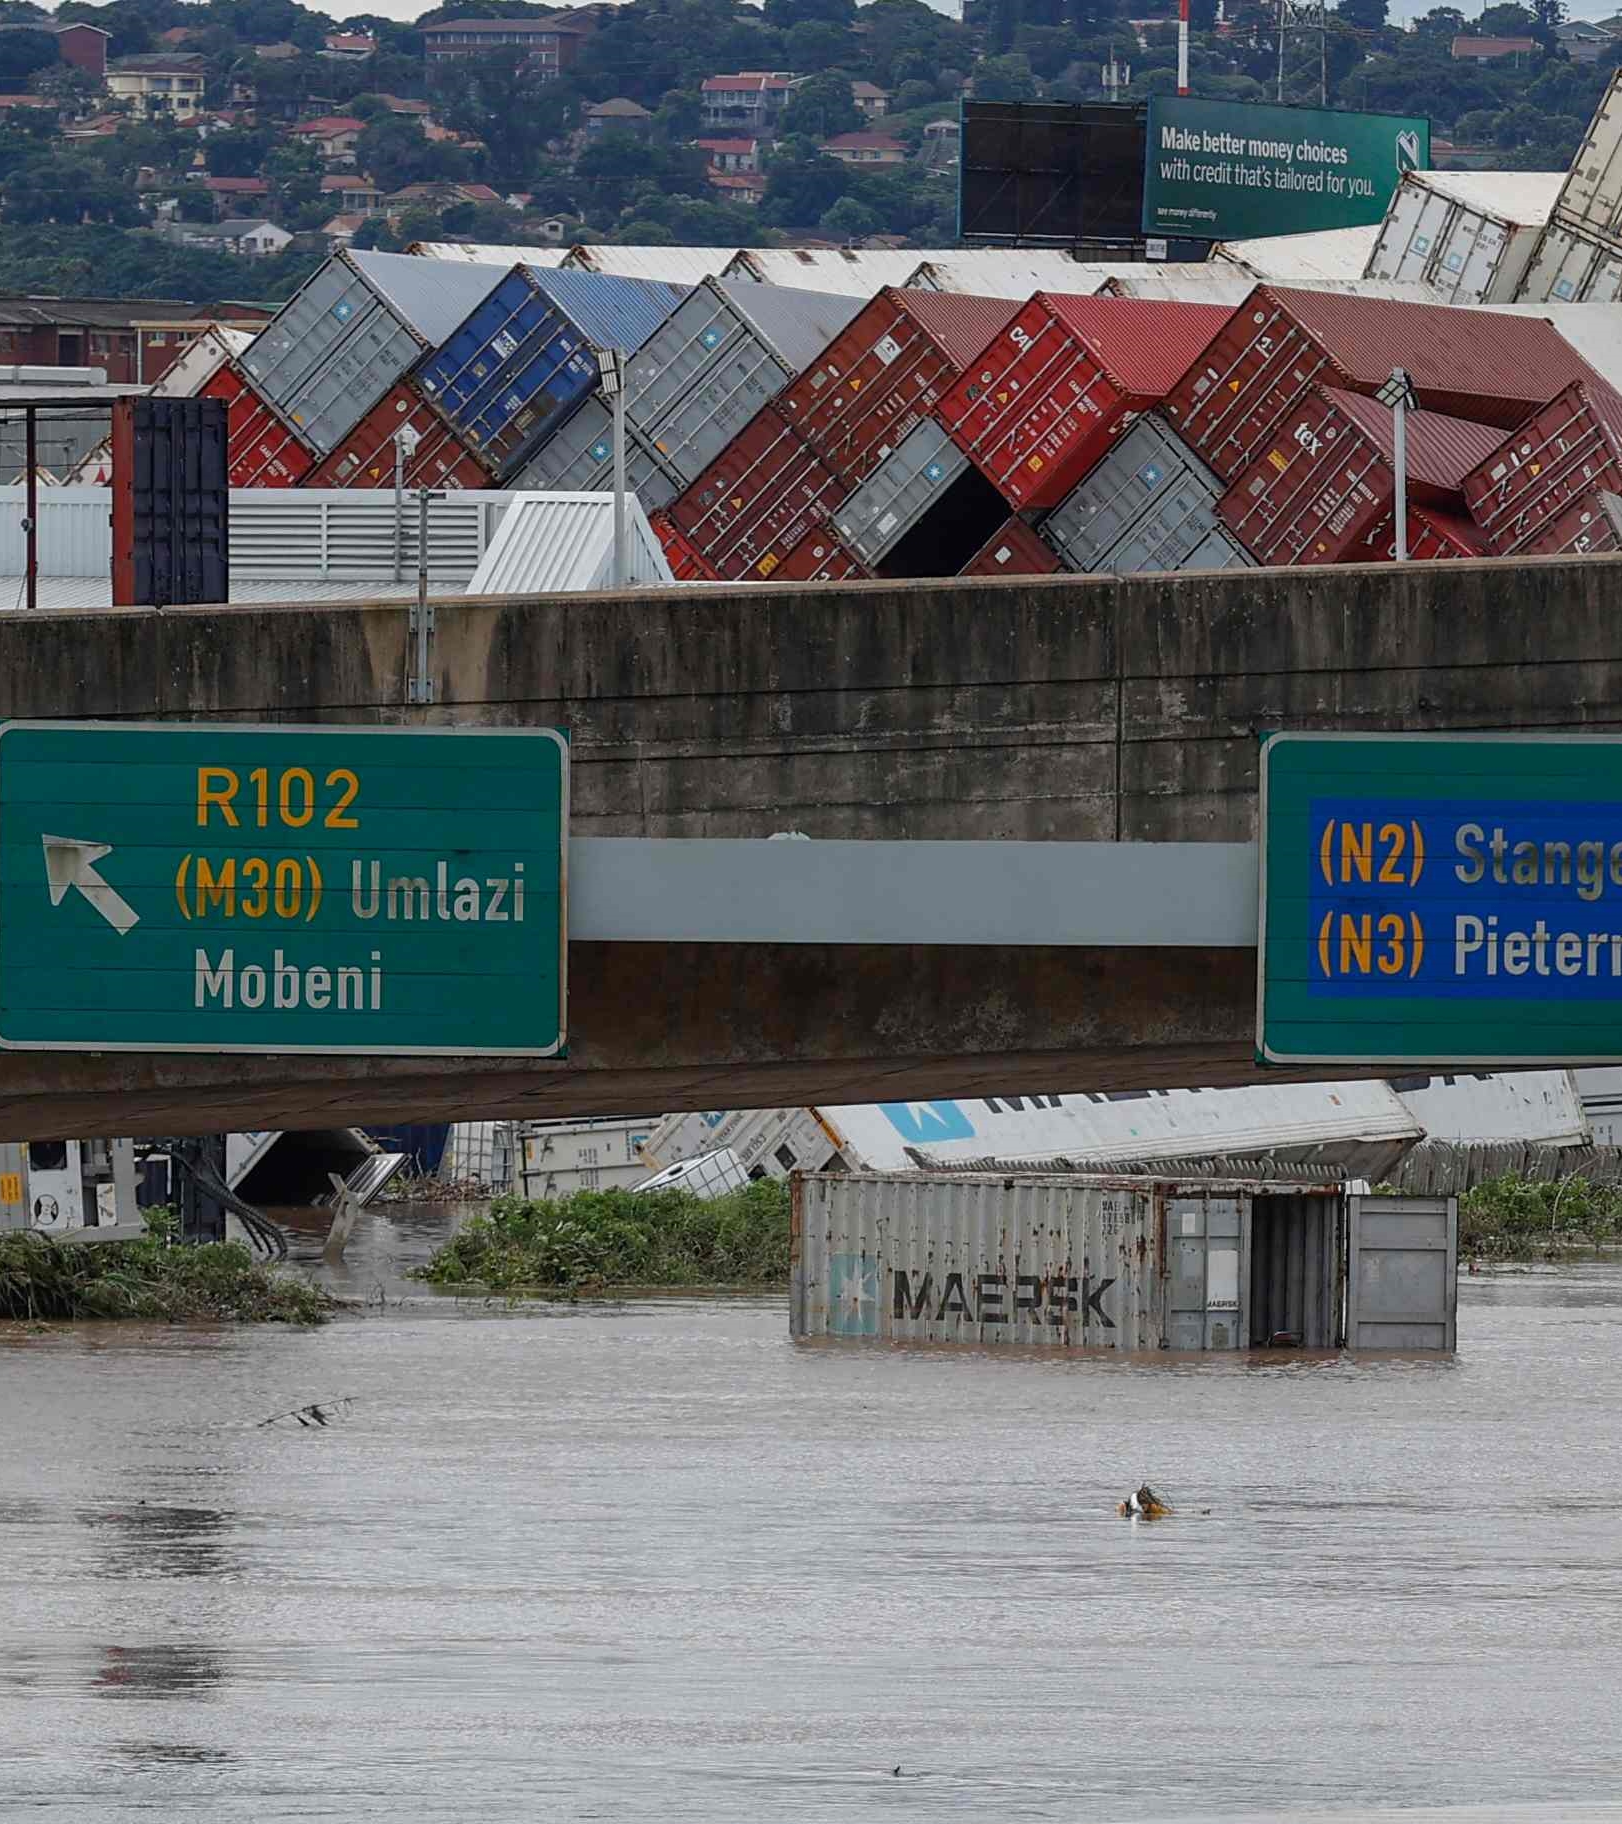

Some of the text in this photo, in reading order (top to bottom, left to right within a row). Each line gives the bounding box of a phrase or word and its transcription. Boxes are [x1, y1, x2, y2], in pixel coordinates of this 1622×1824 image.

[1161, 126, 1348, 164] Make better money choices
[1160, 158, 1375, 199] with credit that's tailored for you.
[197, 767, 360, 828] R102
[1319, 818, 1425, 888] (N2)
[175, 853, 524, 922] (M30) Umlazi
[1318, 911, 1424, 979] (N3)
[194, 949, 381, 1010] Mobeni
[894, 1269, 1116, 1328] MAERSK
